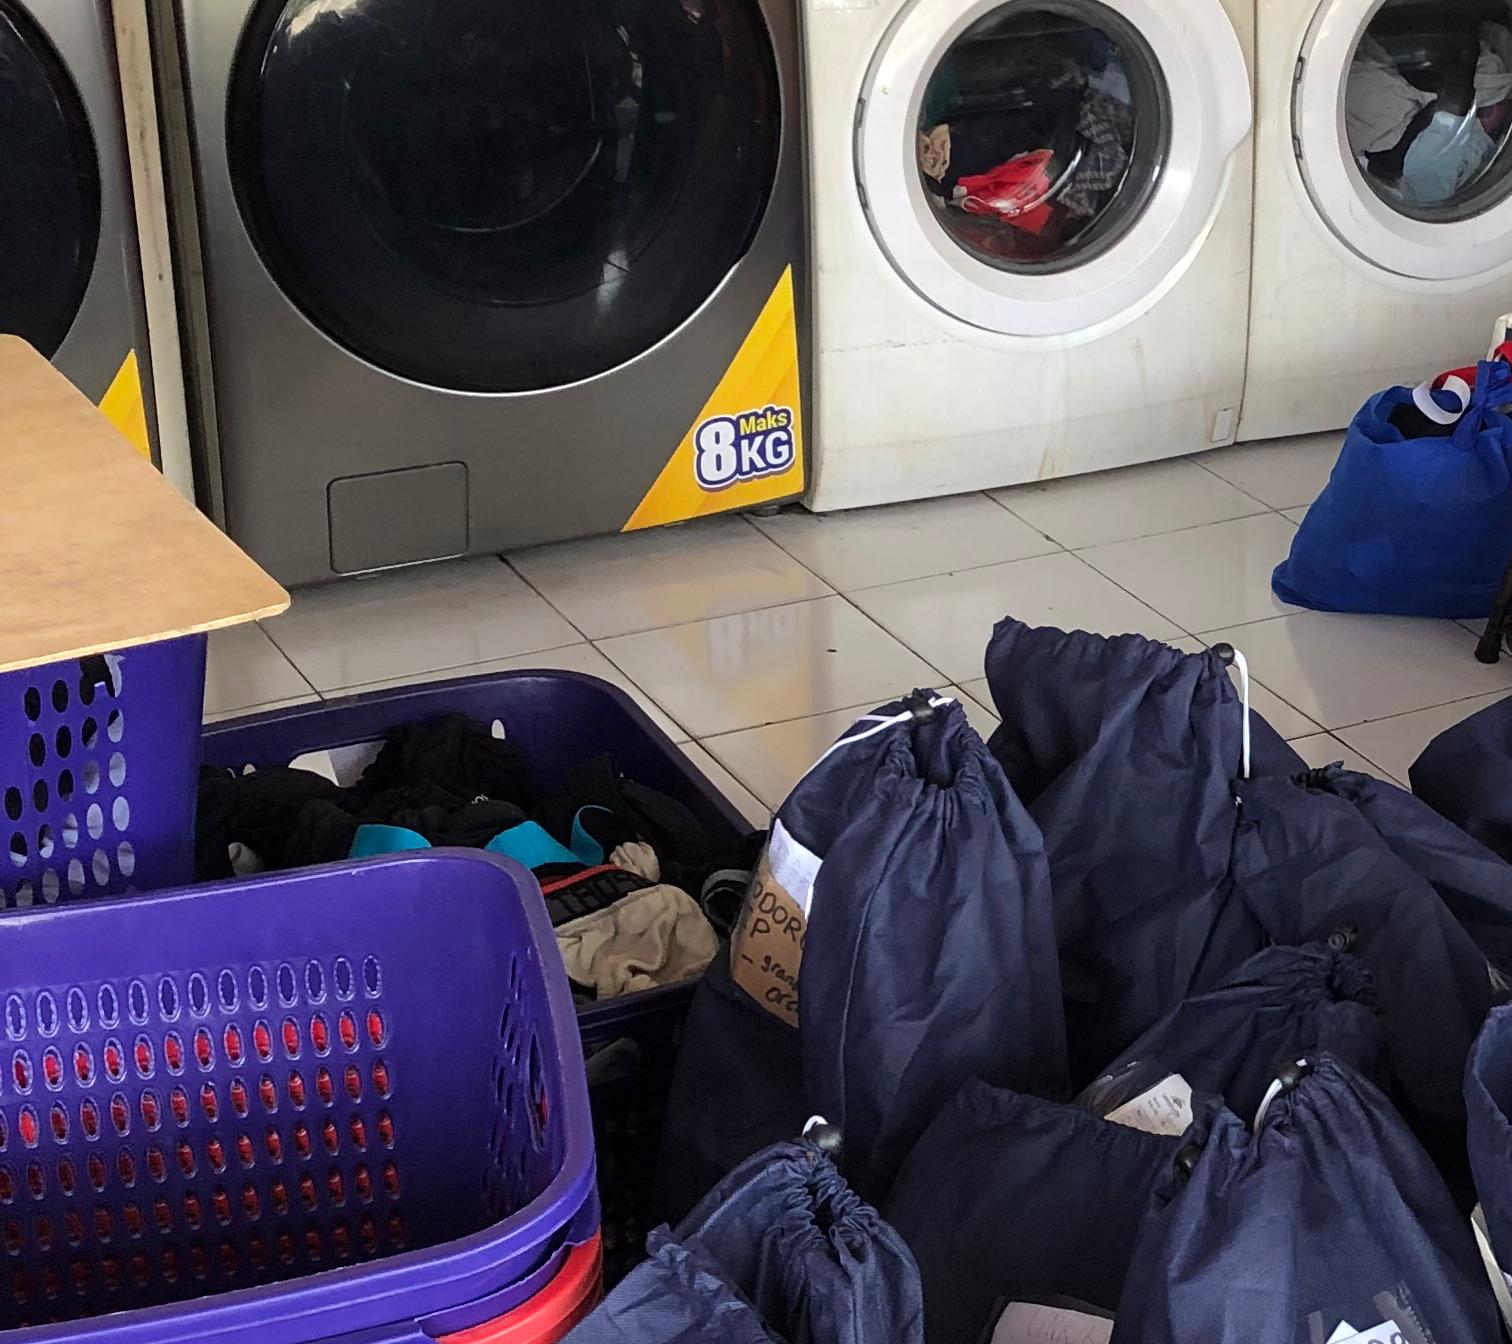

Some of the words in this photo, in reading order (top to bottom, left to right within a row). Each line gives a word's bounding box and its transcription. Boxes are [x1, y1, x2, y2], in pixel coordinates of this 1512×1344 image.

[739, 411, 788, 436] Maks
[699, 421, 737, 482] 8
[740, 430, 790, 473] KG
